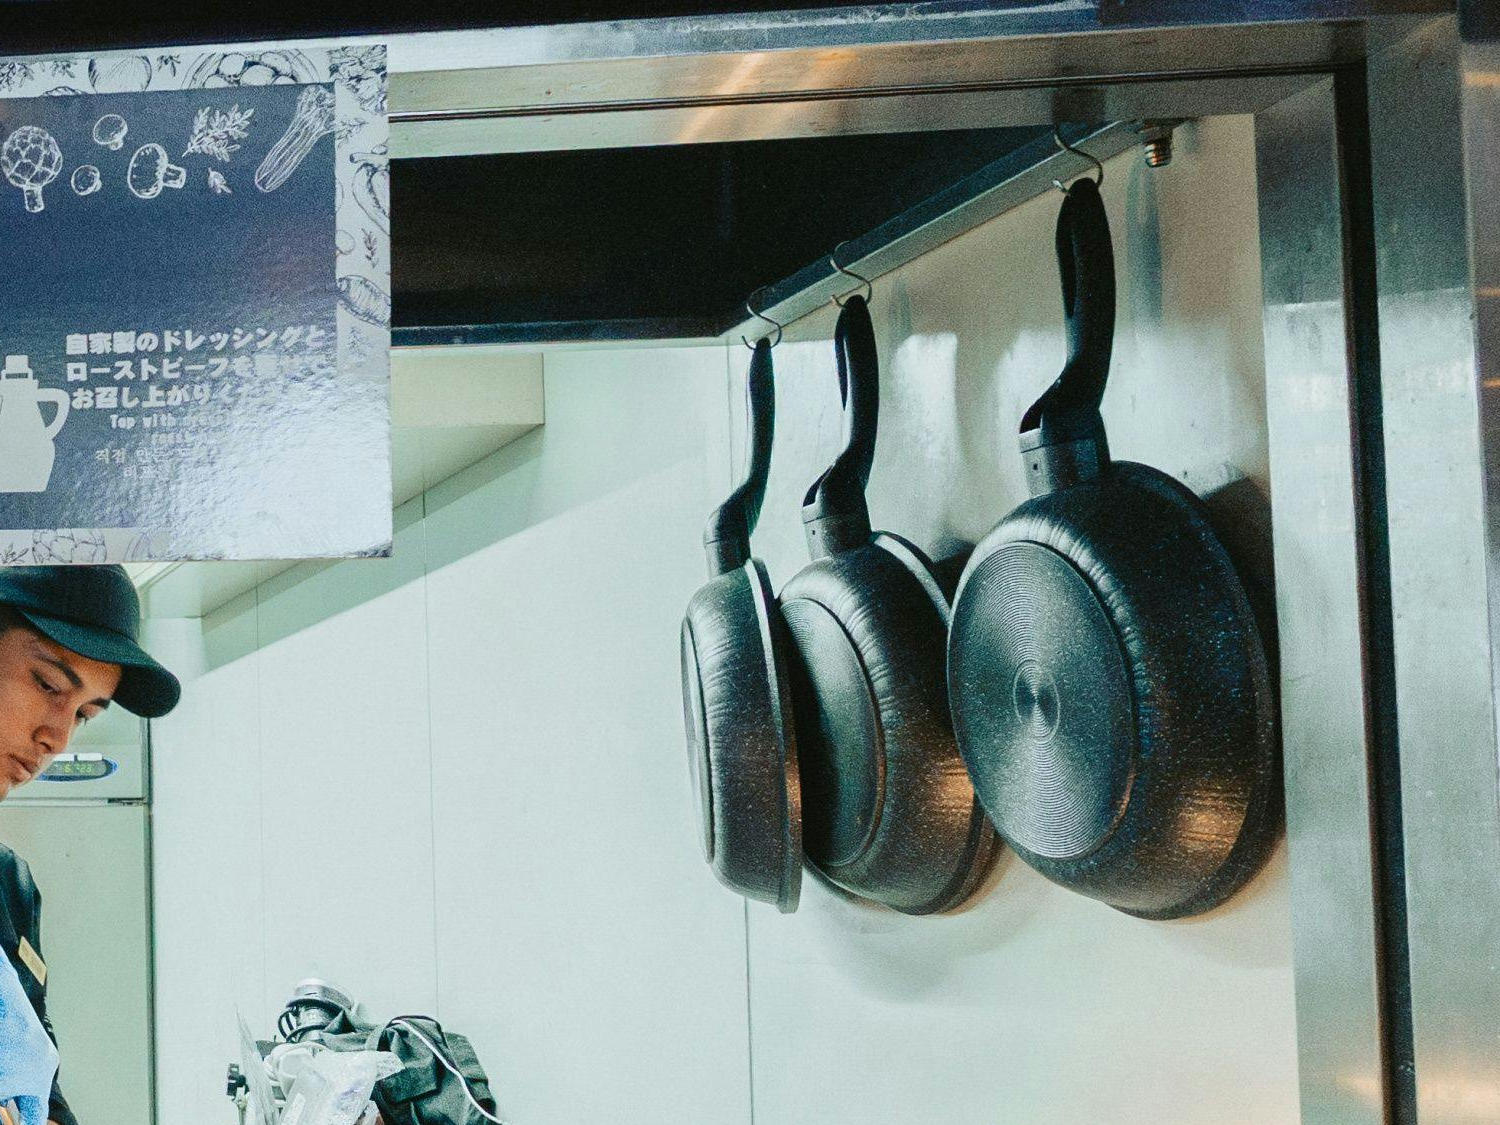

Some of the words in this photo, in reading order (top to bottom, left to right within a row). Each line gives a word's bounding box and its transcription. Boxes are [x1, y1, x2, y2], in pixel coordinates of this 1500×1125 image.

[66, 325, 328, 356] 自家製のドレッシングと
